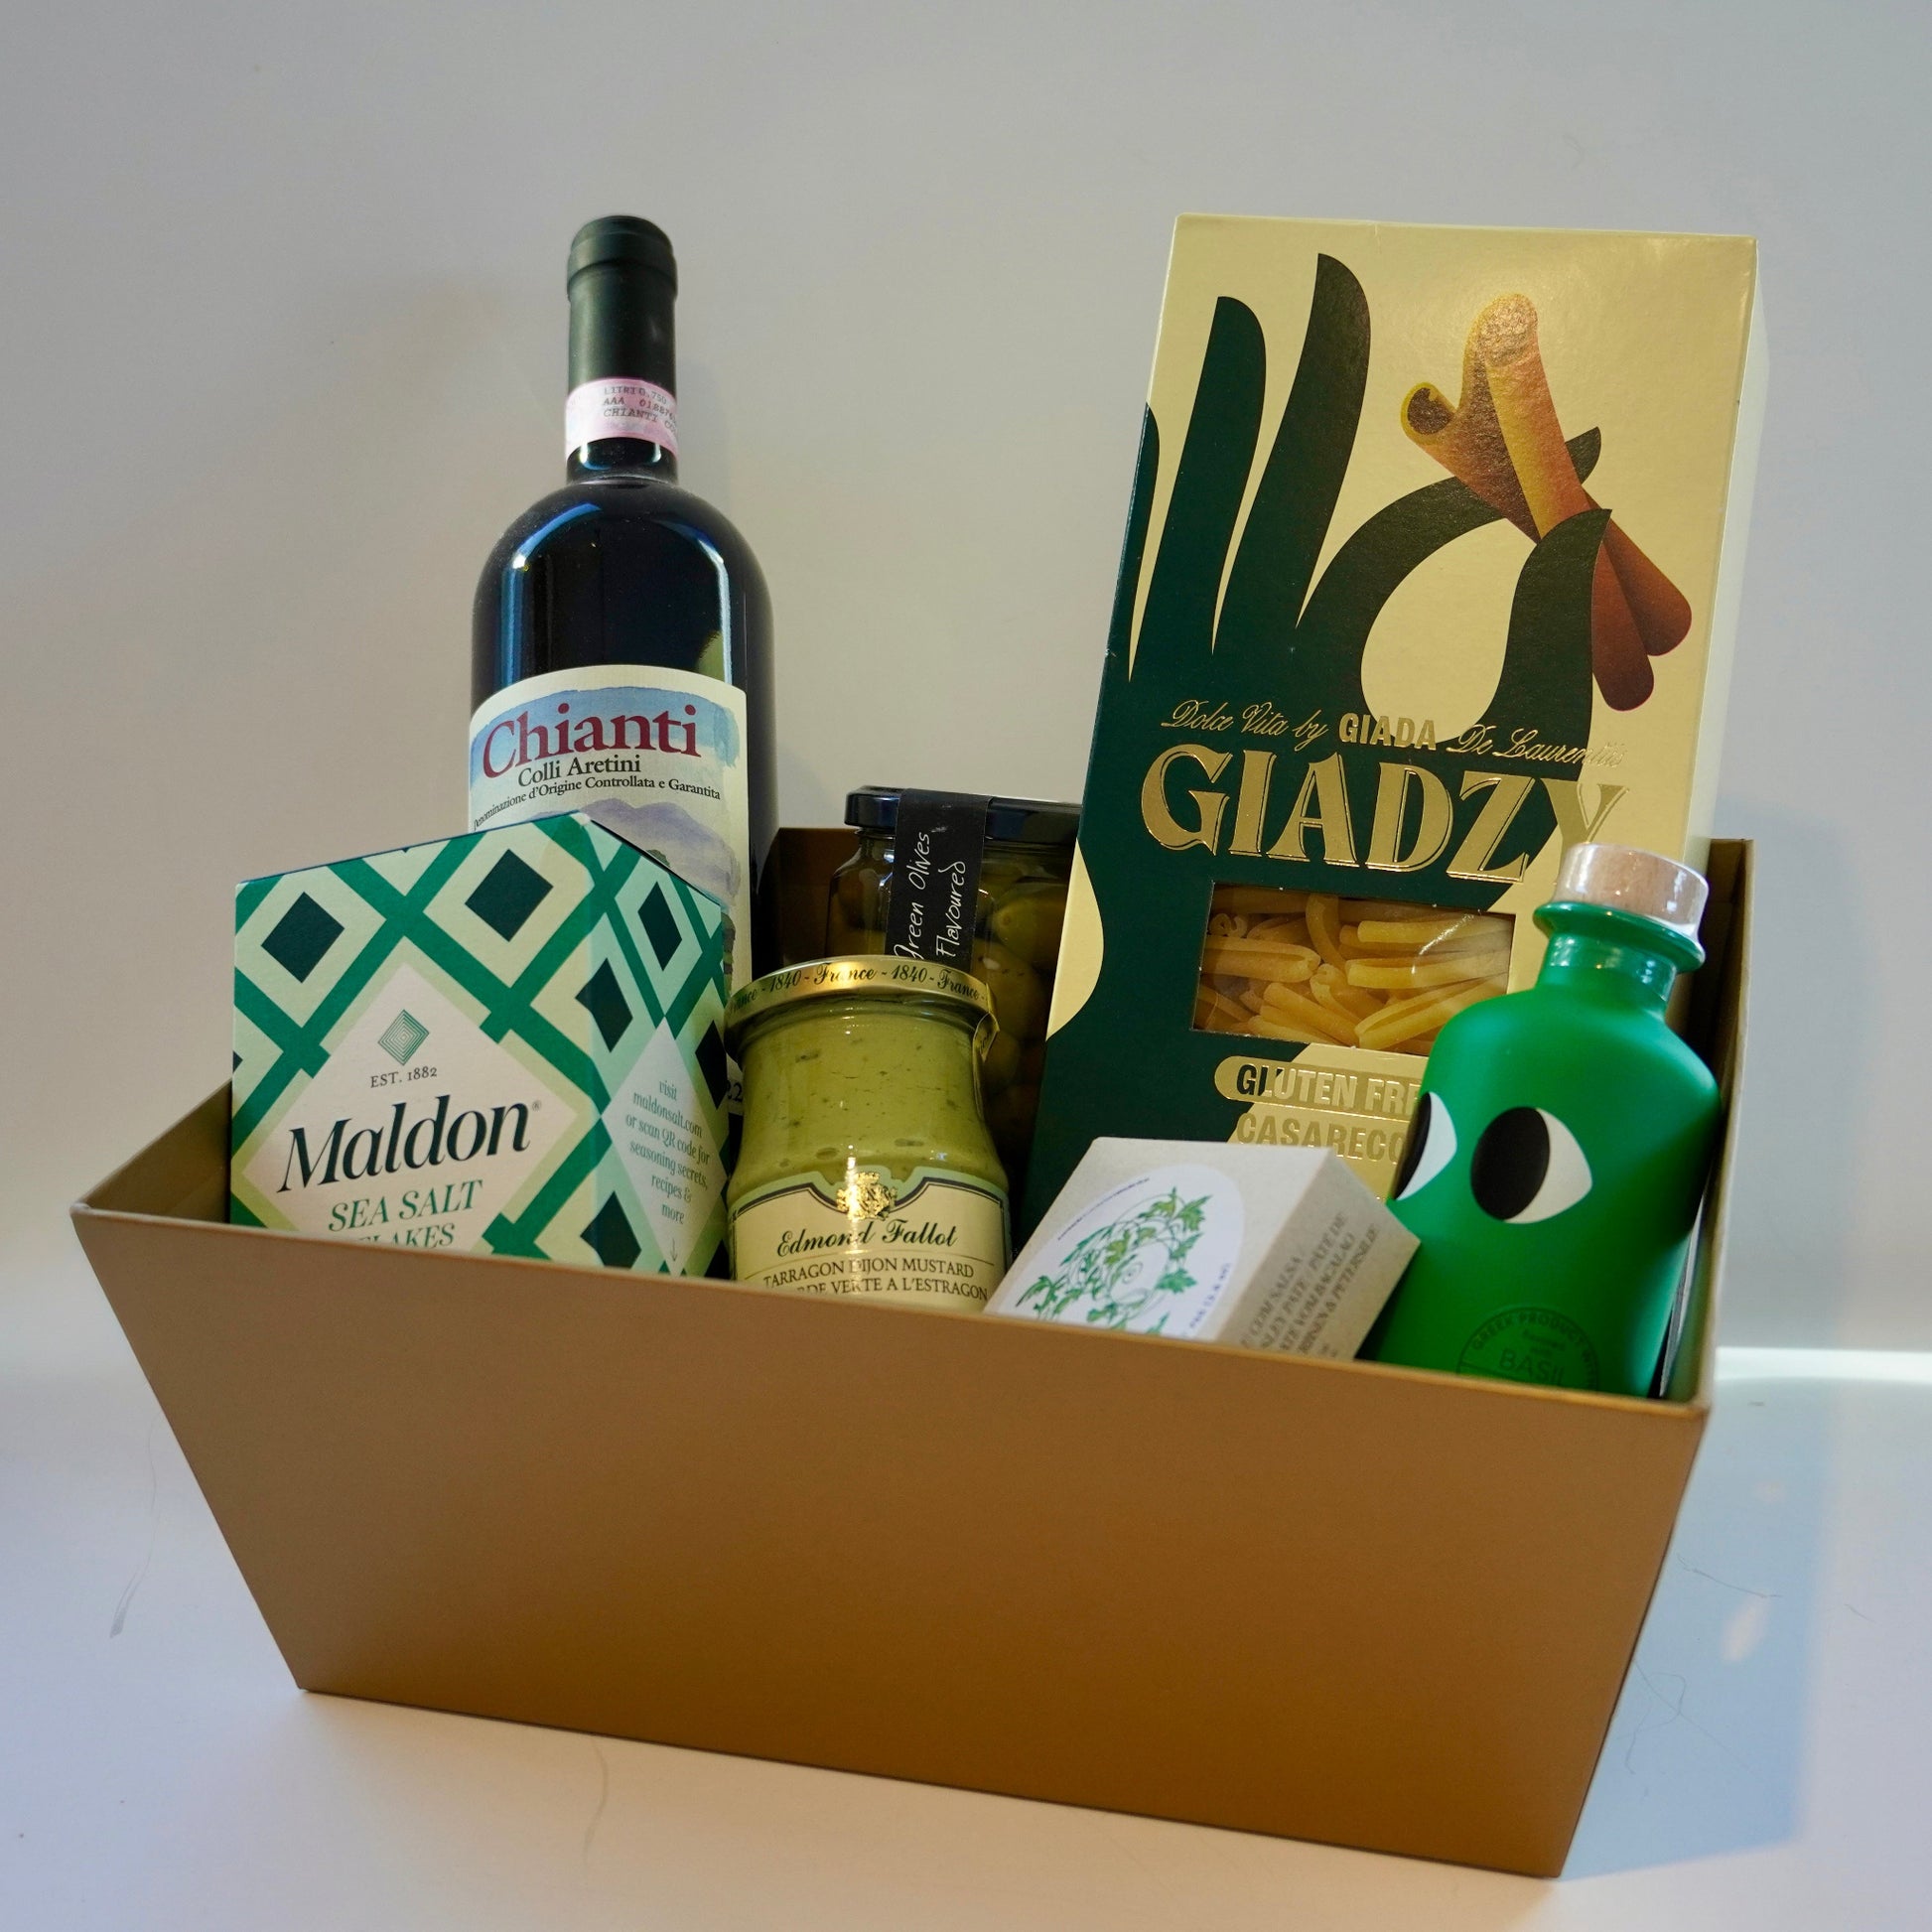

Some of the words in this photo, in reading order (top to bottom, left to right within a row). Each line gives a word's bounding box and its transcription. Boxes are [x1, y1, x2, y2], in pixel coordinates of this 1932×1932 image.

[604, 396, 625, 406] AAA
[604, 405, 659, 423] CHIANTI
[483, 703, 702, 778] Chianti
[1161, 699, 1234, 733] Dolce
[1242, 704, 1292, 736] Vita
[1293, 709, 1329, 753] by
[1337, 712, 1437, 752] GIADA
[1446, 724, 1497, 755] De
[518, 759, 561, 787] Colli
[568, 755, 641, 777] Aretini
[528, 779, 583, 800] d'Origine
[585, 774, 655, 789] Controllata
[658, 779, 666, 789] e
[668, 778, 721, 800] Garantita
[1141, 744, 1631, 884] GIADZY
[905, 831, 931, 891] Olives
[935, 861, 966, 957] Flavoured
[769, 971, 802, 993] 1840
[892, 964, 927, 984] 1840
[937, 968, 980, 1001] France
[370, 1072, 402, 1089] EST.
[407, 1066, 438, 1082] 1882
[658, 1079, 678, 1102] visit
[1236, 1062, 1358, 1110] GLUTEN
[632, 1091, 703, 1139] maldonsalt.com
[624, 1114, 637, 1129] or
[638, 1120, 660, 1140] scan
[661, 1125, 675, 1148] QR
[677, 1136, 697, 1159] code
[697, 1147, 711, 1166] for
[629, 1140, 676, 1176] seasoning
[329, 1195, 390, 1233] SEA
[399, 1179, 483, 1221] SALT
[650, 1173, 683, 1197] recipes
[684, 1187, 693, 1203] &
[661, 1202, 685, 1225] more
[776, 1220, 876, 1257] Edmond
[882, 1218, 959, 1248] Fallot
[763, 1260, 845, 1288] TARRAGON
[849, 1257, 897, 1275] DIJON
[901, 1257, 975, 1279] MUSTARD
[831, 1277, 884, 1295] VERTE
[903, 1277, 990, 1302] L'ESTRAGON
